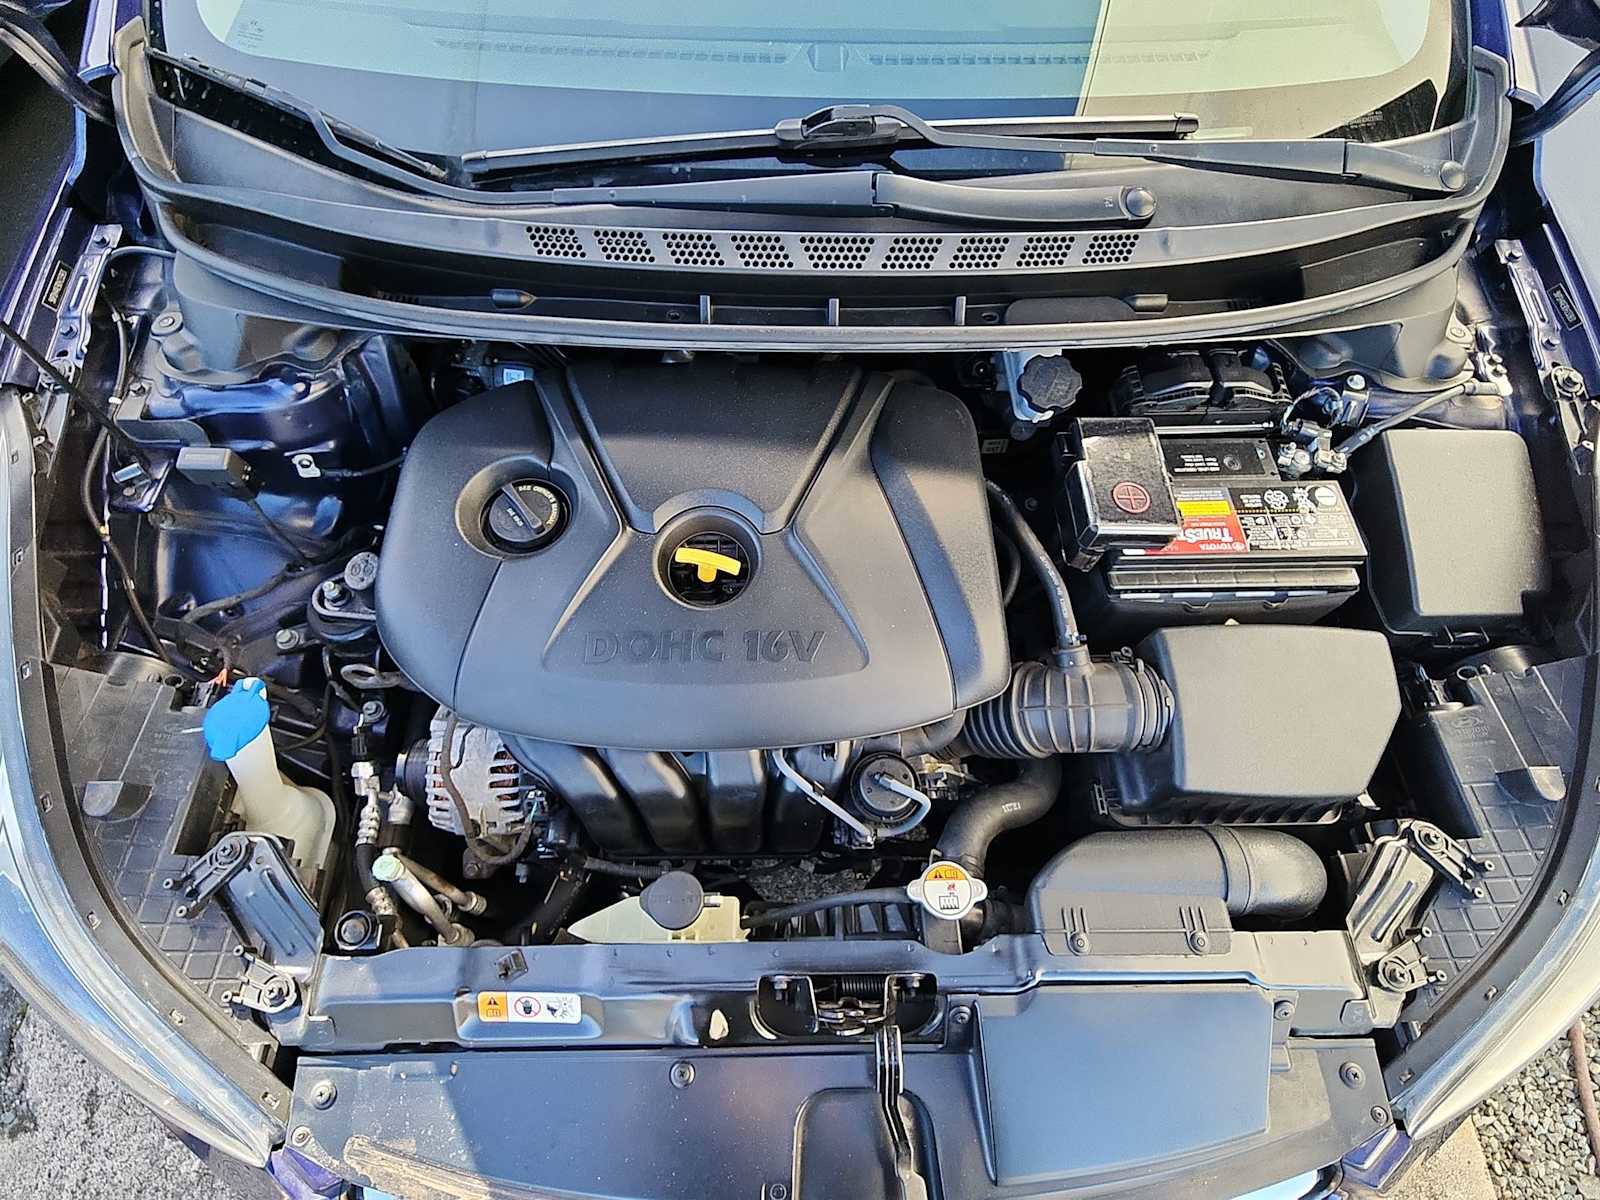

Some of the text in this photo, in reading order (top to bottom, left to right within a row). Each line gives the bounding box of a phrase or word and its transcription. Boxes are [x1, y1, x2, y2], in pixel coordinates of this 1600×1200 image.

[1199, 542, 1233, 551] TOYOTA
[583, 629, 829, 665] DOHC 16V
